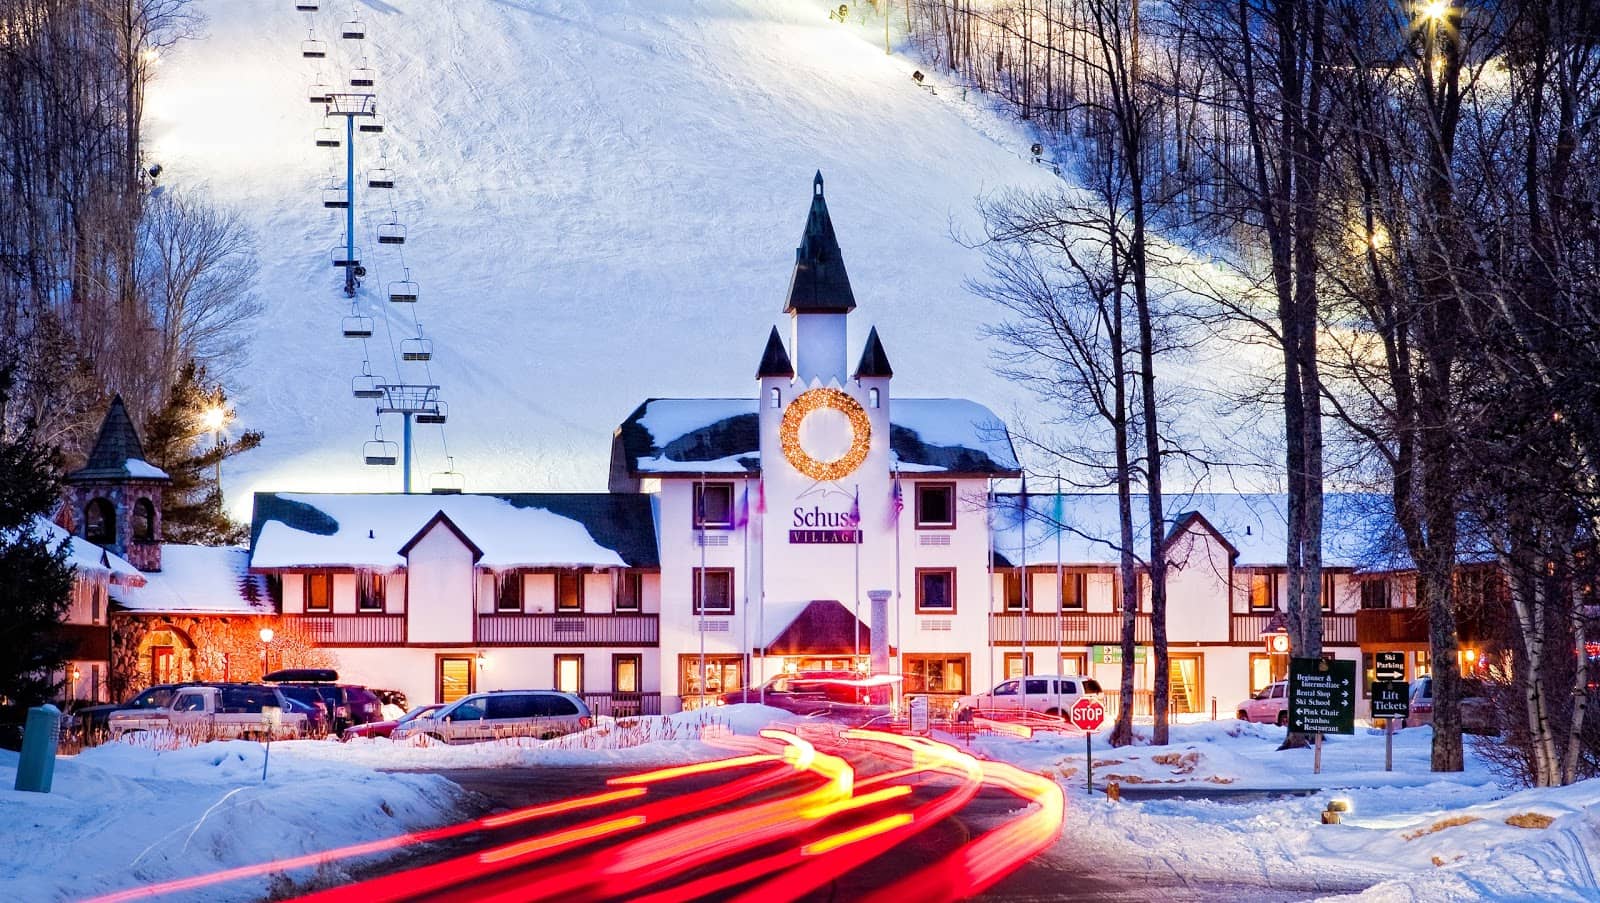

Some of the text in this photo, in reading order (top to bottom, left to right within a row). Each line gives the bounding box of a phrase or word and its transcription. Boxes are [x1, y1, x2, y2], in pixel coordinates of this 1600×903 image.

[1376, 661, 1404, 669] Parking
[1382, 690, 1399, 700] Lift
[1373, 700, 1408, 710] Tickets
[1073, 708, 1103, 721] STOP
[1303, 708, 1319, 716] Pink
[1304, 723, 1339, 731] Restaurant
